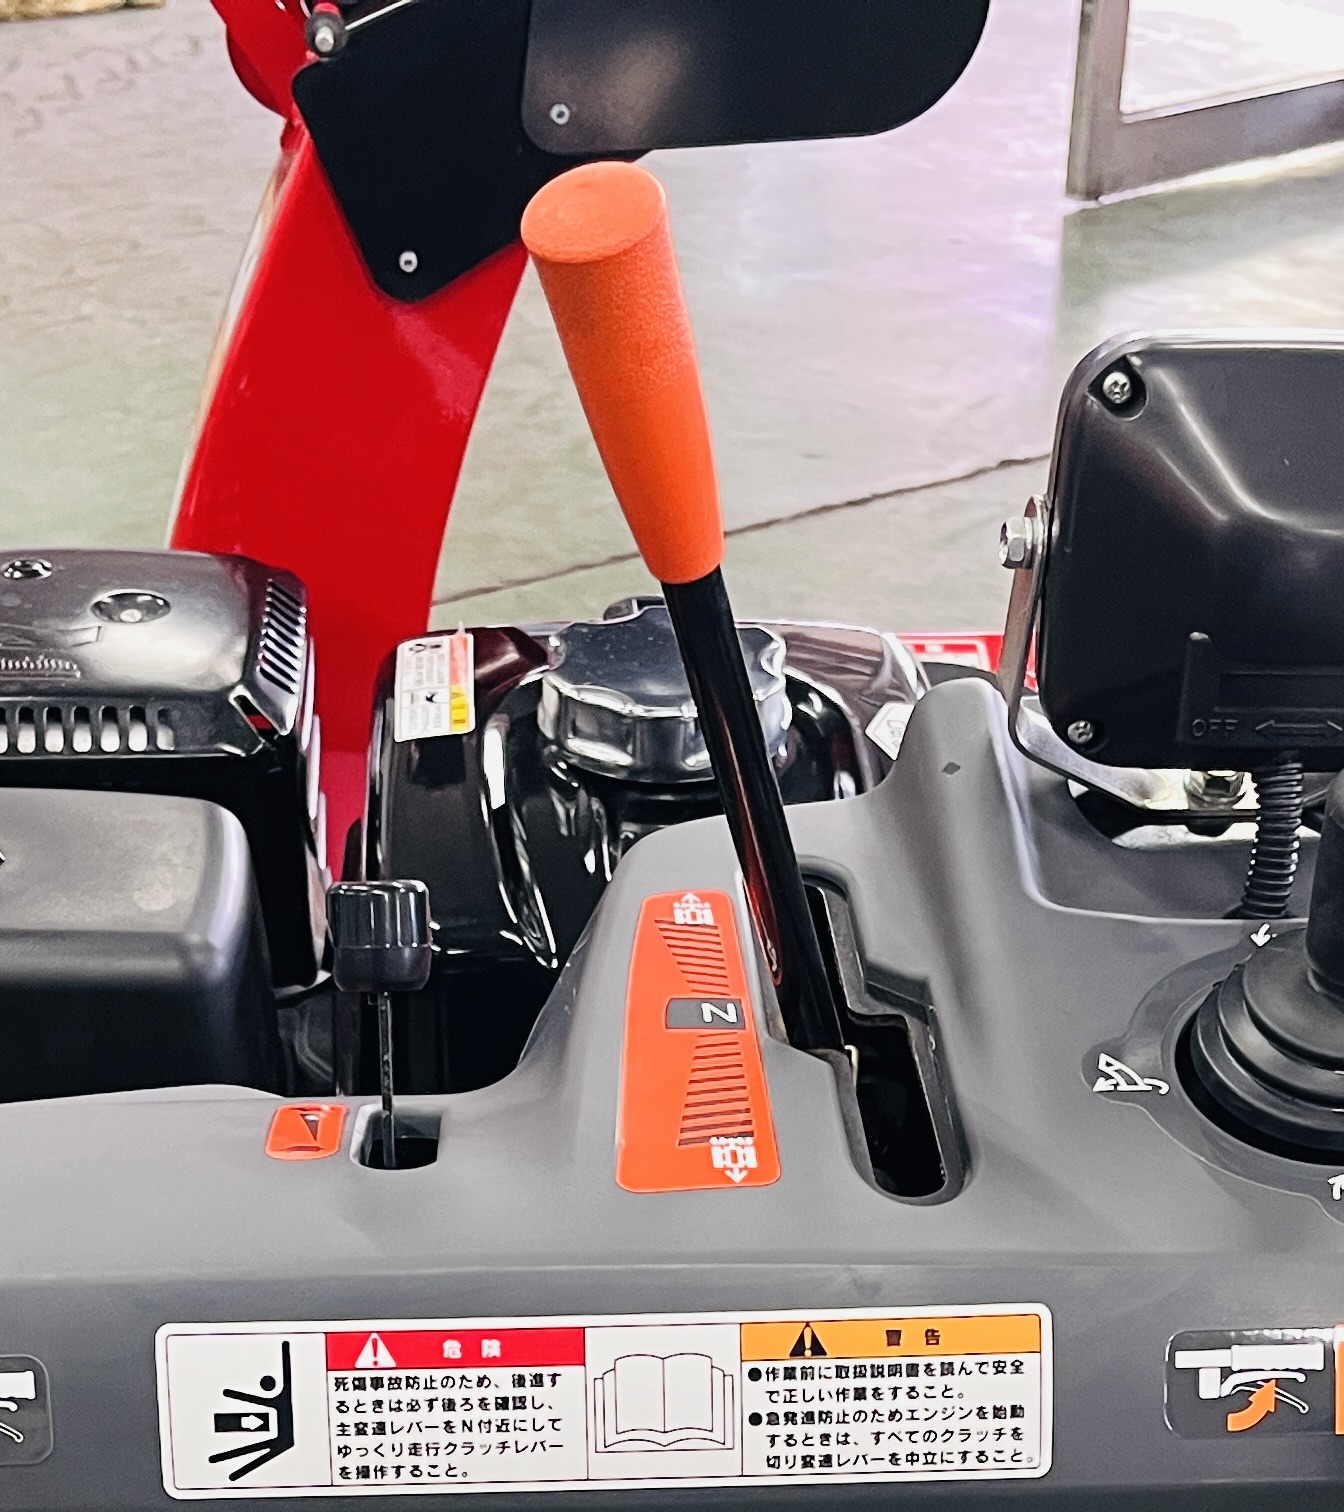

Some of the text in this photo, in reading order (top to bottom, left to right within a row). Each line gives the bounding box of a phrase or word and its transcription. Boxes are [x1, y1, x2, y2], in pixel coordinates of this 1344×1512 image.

[1191, 717, 1239, 738] OFF
[701, 1002, 738, 1023] N
[442, 1338, 502, 1360] 危険
[337, 1440, 564, 1458] ゆっくり走行クラッチレバー
[338, 1463, 469, 1480] を操作すること。
